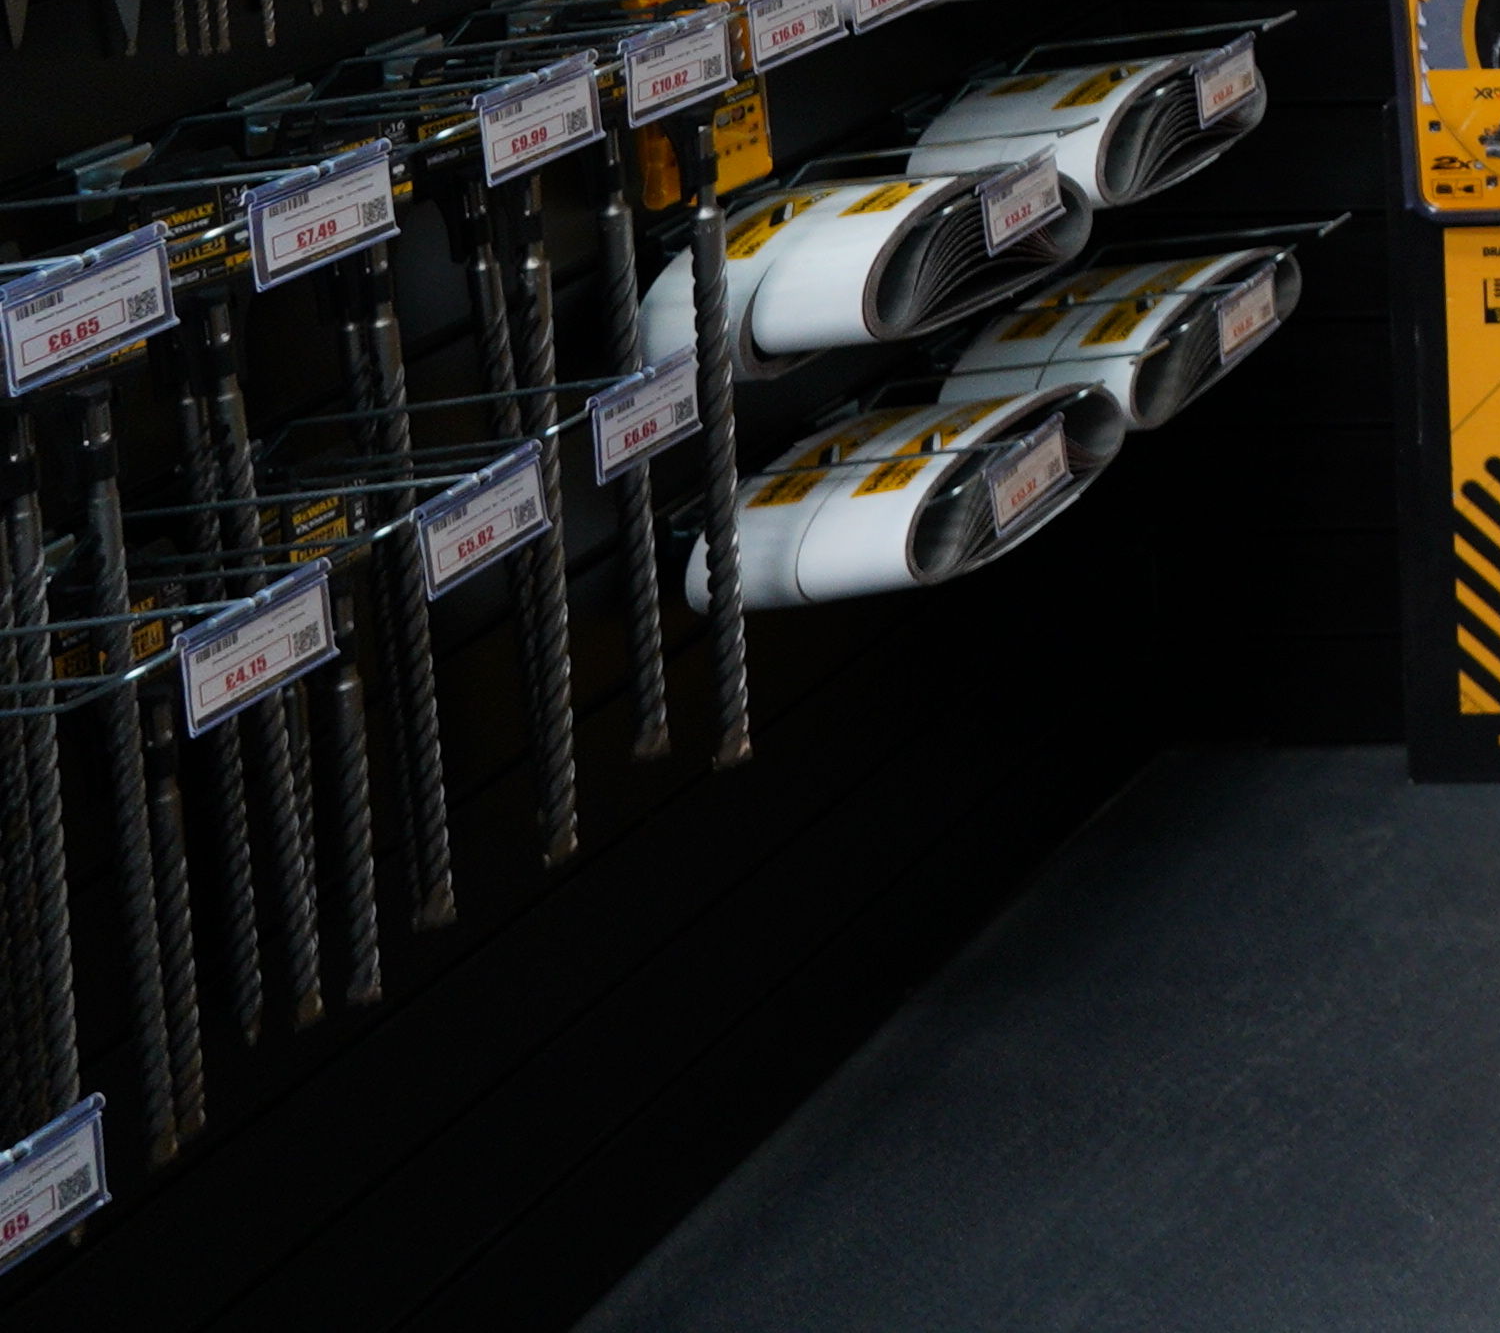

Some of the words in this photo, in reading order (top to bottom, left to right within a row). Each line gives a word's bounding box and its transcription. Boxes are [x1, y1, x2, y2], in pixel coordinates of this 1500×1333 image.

[650, 71, 688, 98] £10.82
[510, 127, 548, 155] £9.99
[296, 221, 337, 249] £7.49
[47, 318, 100, 353] £6.65
[224, 656, 268, 692] £4.15
